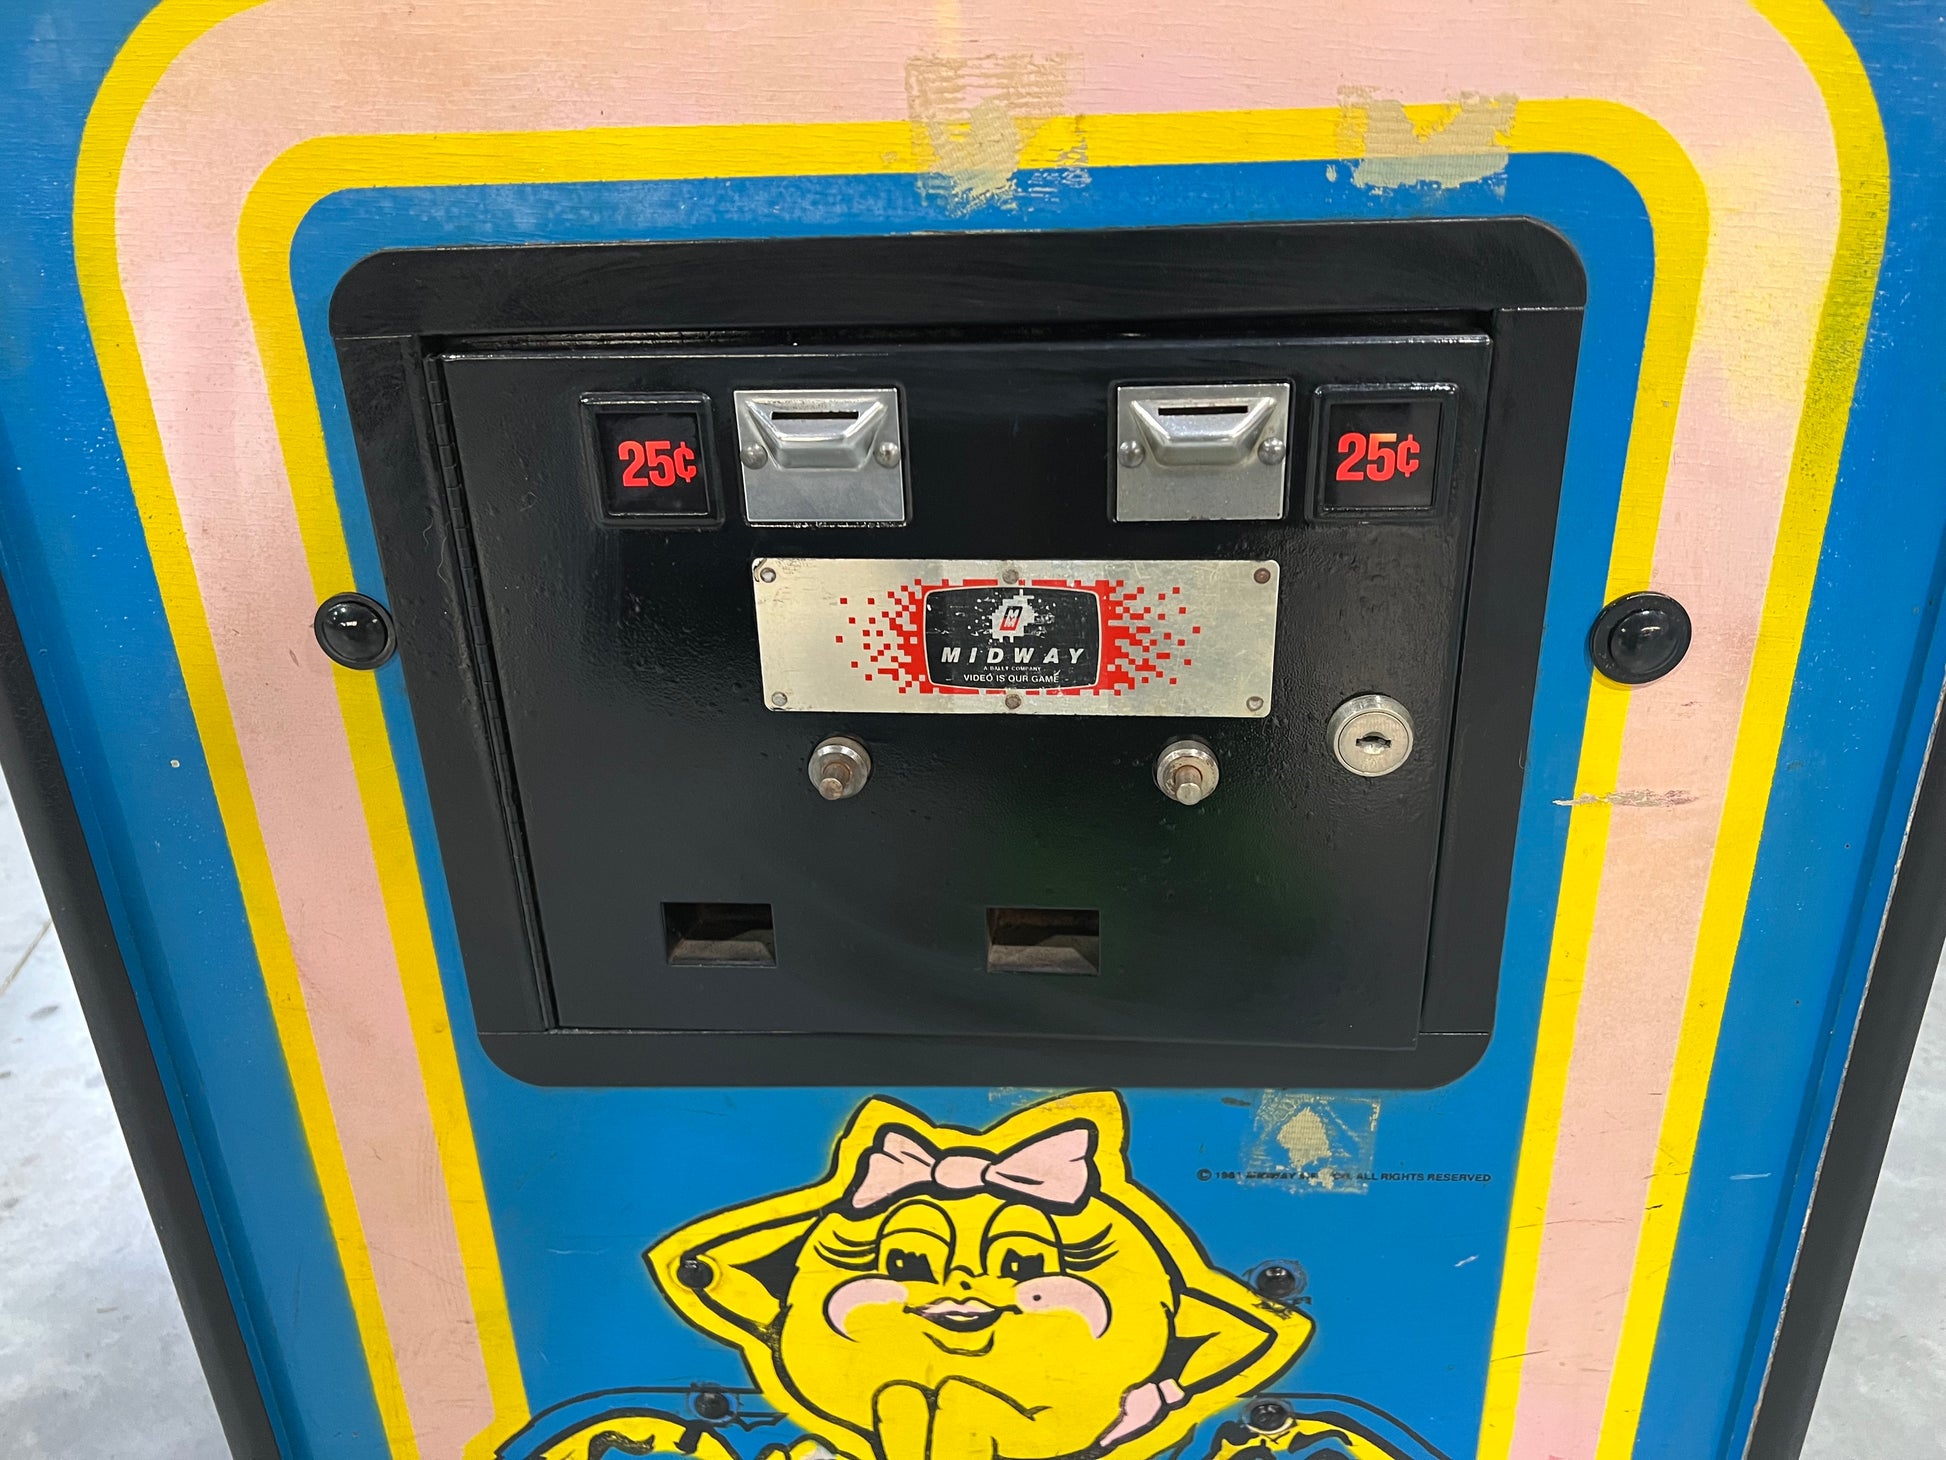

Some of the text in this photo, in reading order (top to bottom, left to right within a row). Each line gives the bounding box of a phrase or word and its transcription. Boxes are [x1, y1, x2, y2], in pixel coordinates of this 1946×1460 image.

[618, 440, 697, 487] 25¢
[1336, 432, 1420, 481] 25¢
[941, 647, 1085, 664] MIDWAY
[963, 674, 1060, 683] VIDEO IS OUR GAME
[1356, 1173, 1378, 1181] ALL
[1381, 1173, 1424, 1181] RIGHTS
[1427, 1173, 1491, 1182] RESERVED
